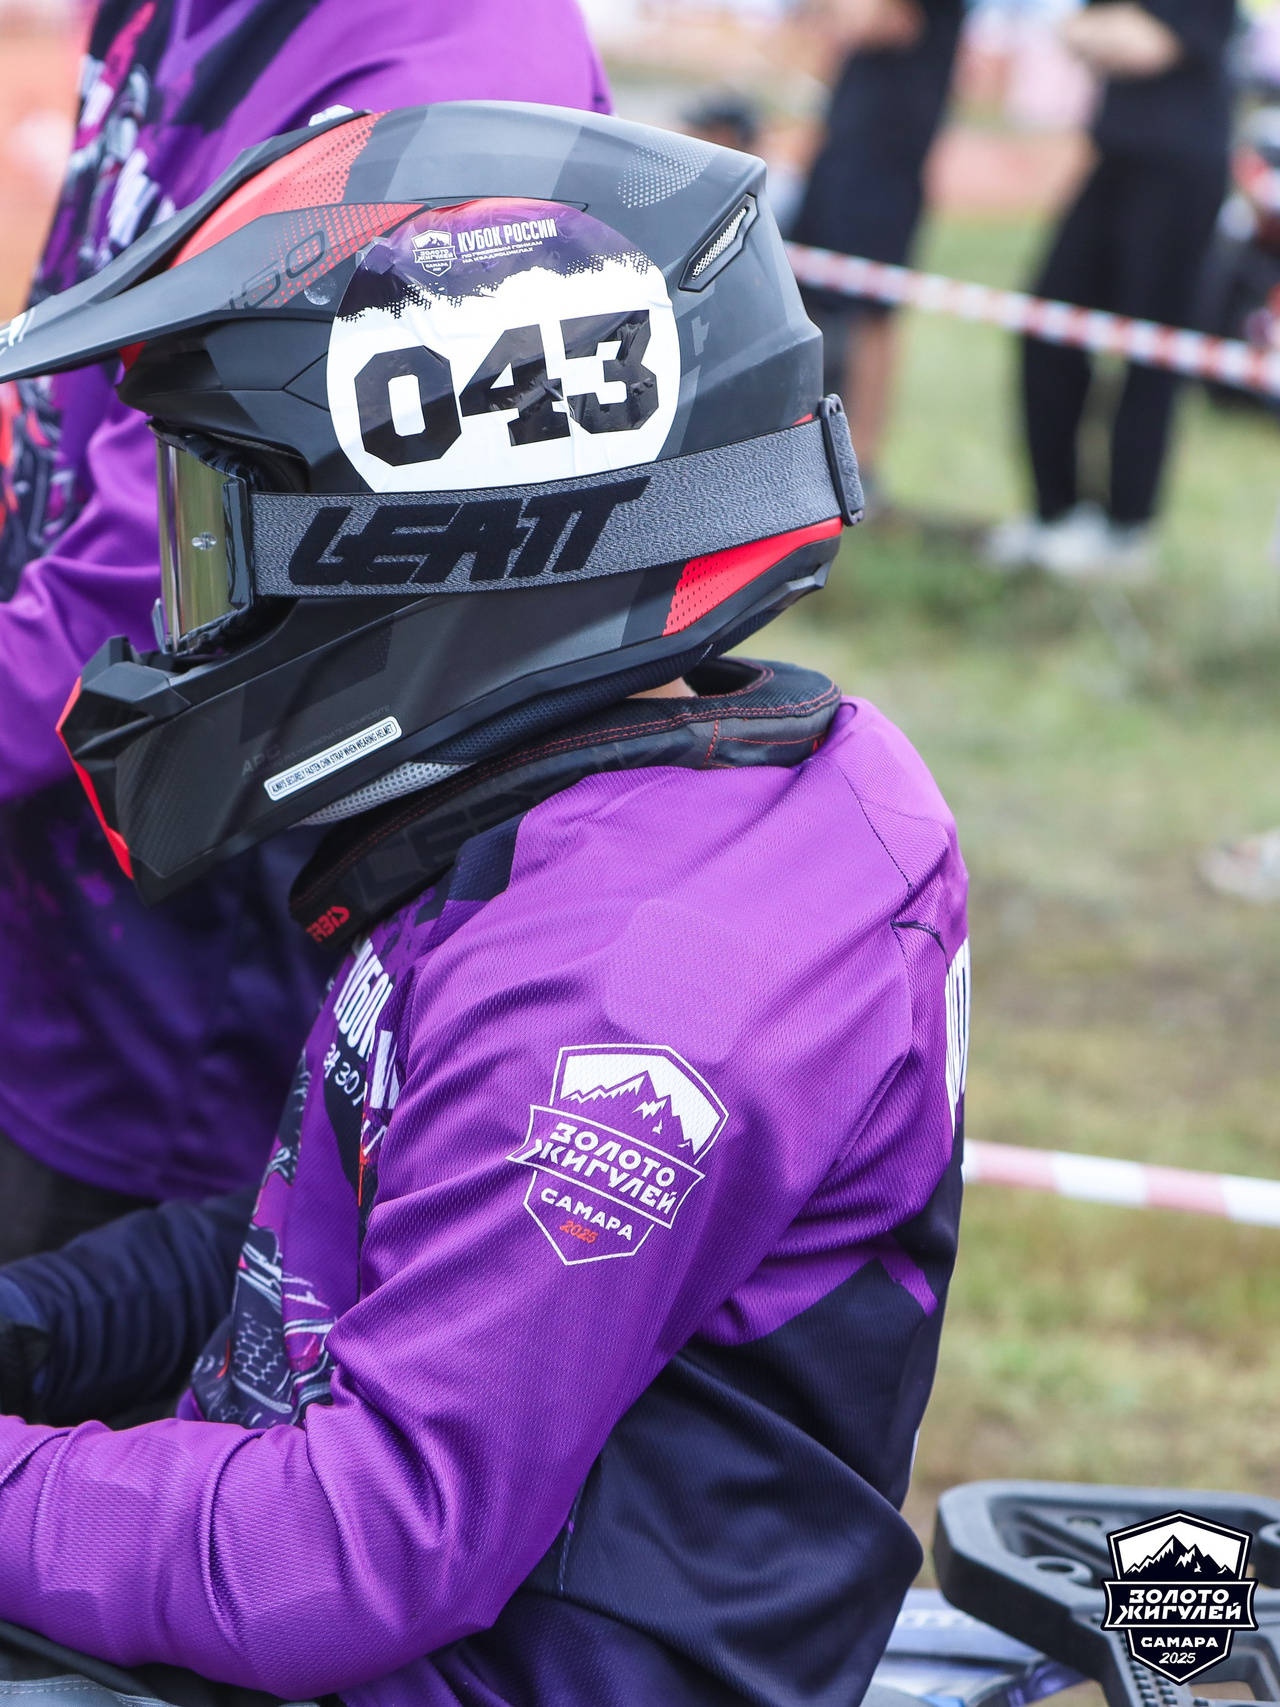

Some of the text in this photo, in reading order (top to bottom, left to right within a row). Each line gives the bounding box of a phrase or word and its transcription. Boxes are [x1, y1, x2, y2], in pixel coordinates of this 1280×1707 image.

[457, 218, 558, 253] КУБОК РОССИИ
[354, 309, 660, 467] 043
[288, 475, 651, 586] LEATT
[304, 762, 322, 777] FASTEN
[320, 757, 332, 769] CHIN
[329, 749, 346, 764] STRAP
[343, 742, 358, 757] WHEN
[356, 732, 378, 750] WEARING
[376, 723, 394, 740] HELMET
[518, 1138, 677, 1215] ЖИГУЛЕЙ
[549, 1122, 675, 1187] ЗОЛОТО
[540, 1187, 634, 1240] САМАРА
[559, 1220, 599, 1244] 2025
